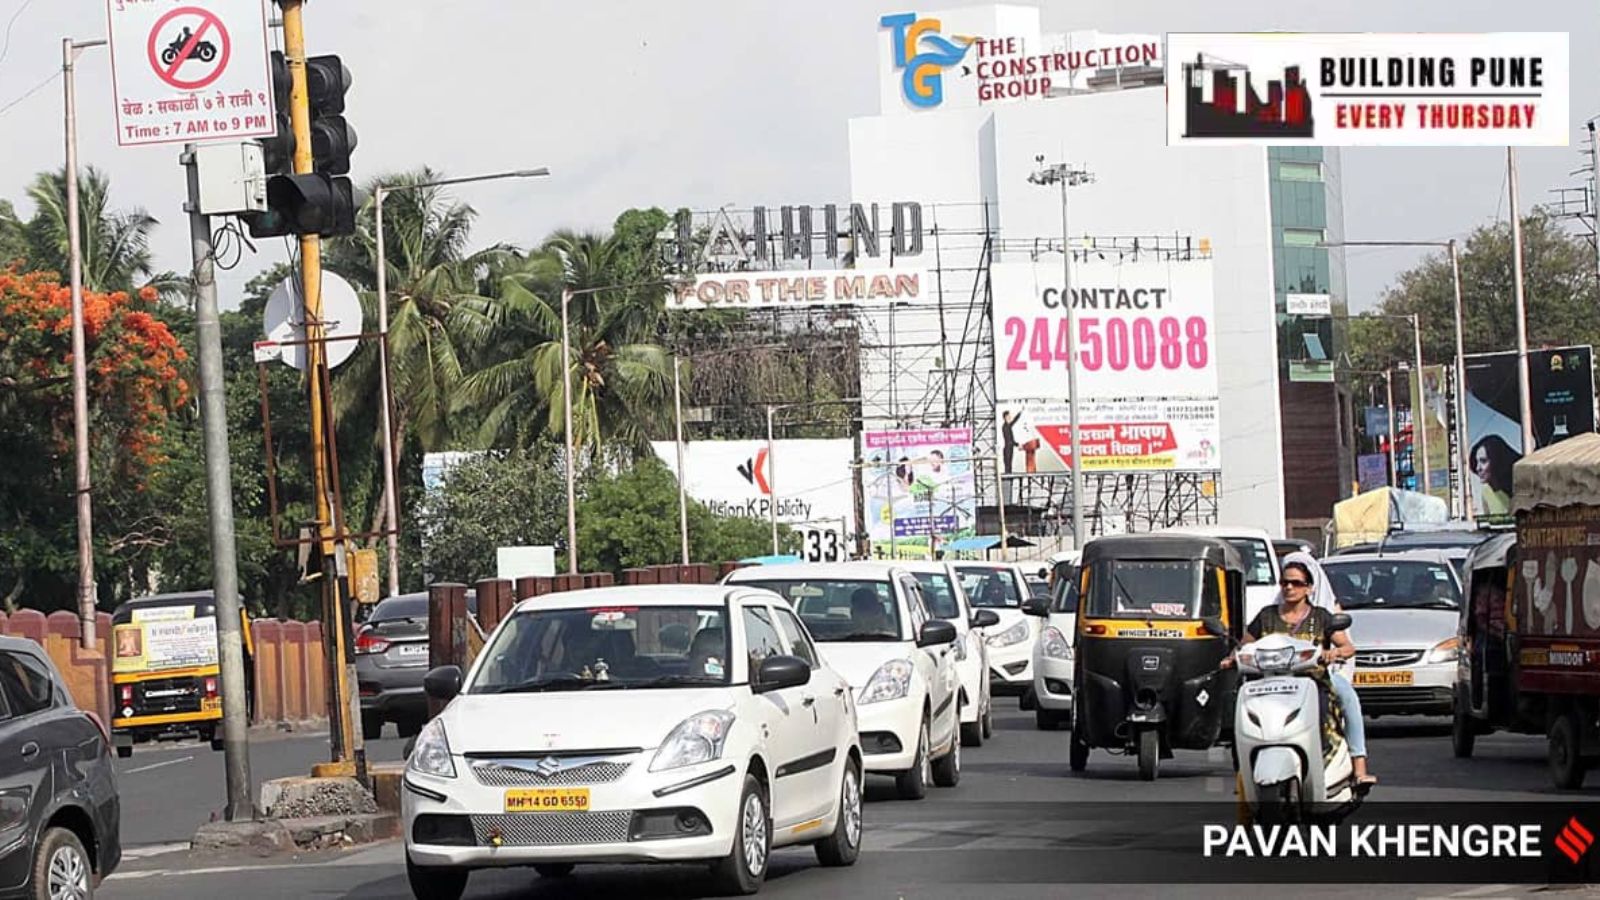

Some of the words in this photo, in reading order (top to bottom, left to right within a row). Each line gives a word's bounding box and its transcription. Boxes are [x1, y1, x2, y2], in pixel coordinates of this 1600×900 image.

[976, 37, 1016, 58] THE
[976, 42, 1157, 80] CONSTRUCTION
[977, 77, 1052, 101] GROUP
[122, 98, 143, 116] वेळ
[215, 91, 225, 109] ते
[125, 125, 160, 139] Time
[173, 122, 182, 134] 7
[187, 119, 209, 134] AM
[213, 119, 228, 132] to
[232, 118, 241, 130] 9
[245, 115, 267, 130] PM
[780, 202, 924, 261] HIND
[672, 280, 749, 305] FOR
[757, 276, 827, 302] THE
[834, 273, 920, 299] MAN
[1043, 288, 1166, 310] CONTACT
[1004, 316, 1208, 371] 24450088
[543, 796, 559, 807] GD
